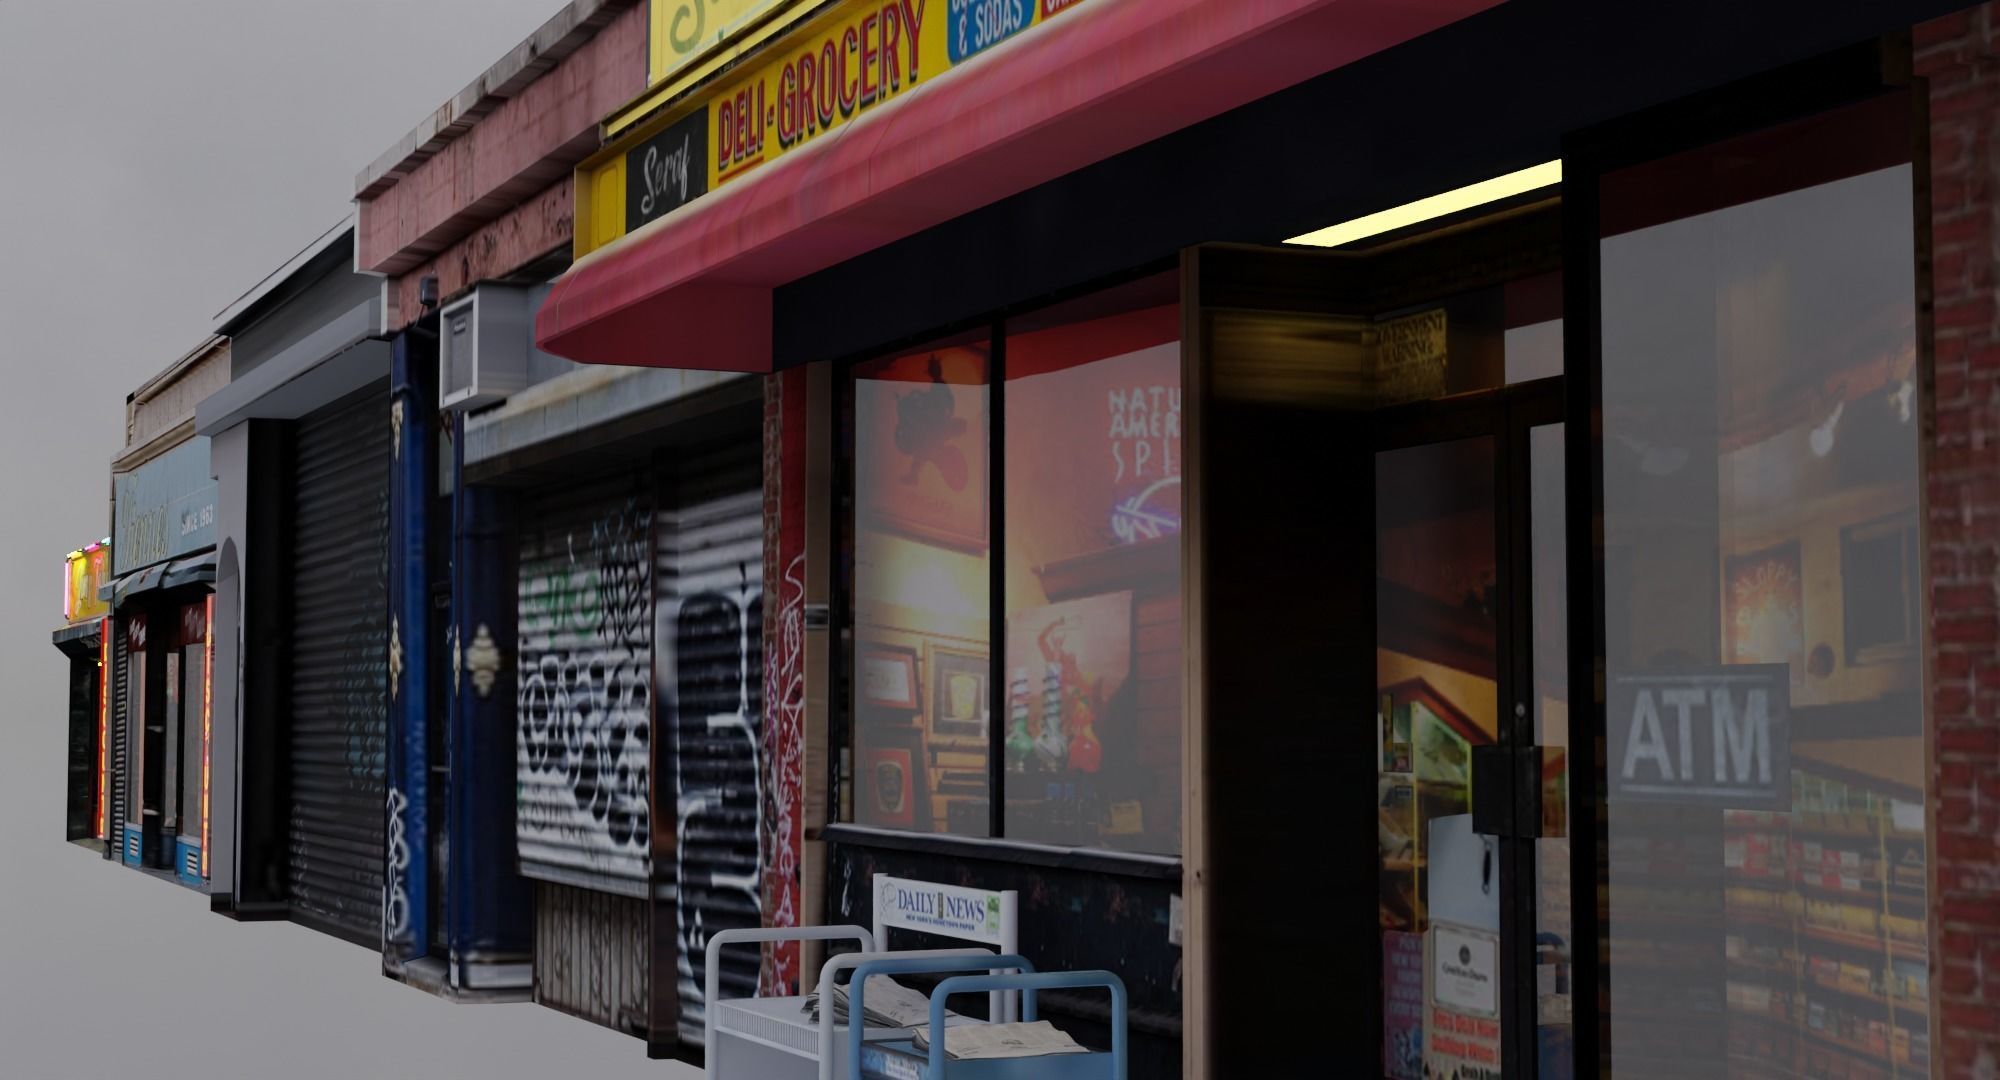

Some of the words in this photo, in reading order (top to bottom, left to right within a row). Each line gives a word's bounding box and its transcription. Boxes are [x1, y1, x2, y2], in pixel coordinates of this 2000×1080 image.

[975, 0, 1023, 49] SODAS
[640, 133, 690, 214] Seraf
[1622, 687, 1773, 785] ATM
[898, 889, 936, 915] DAILY
[946, 896, 985, 923] NEWS
